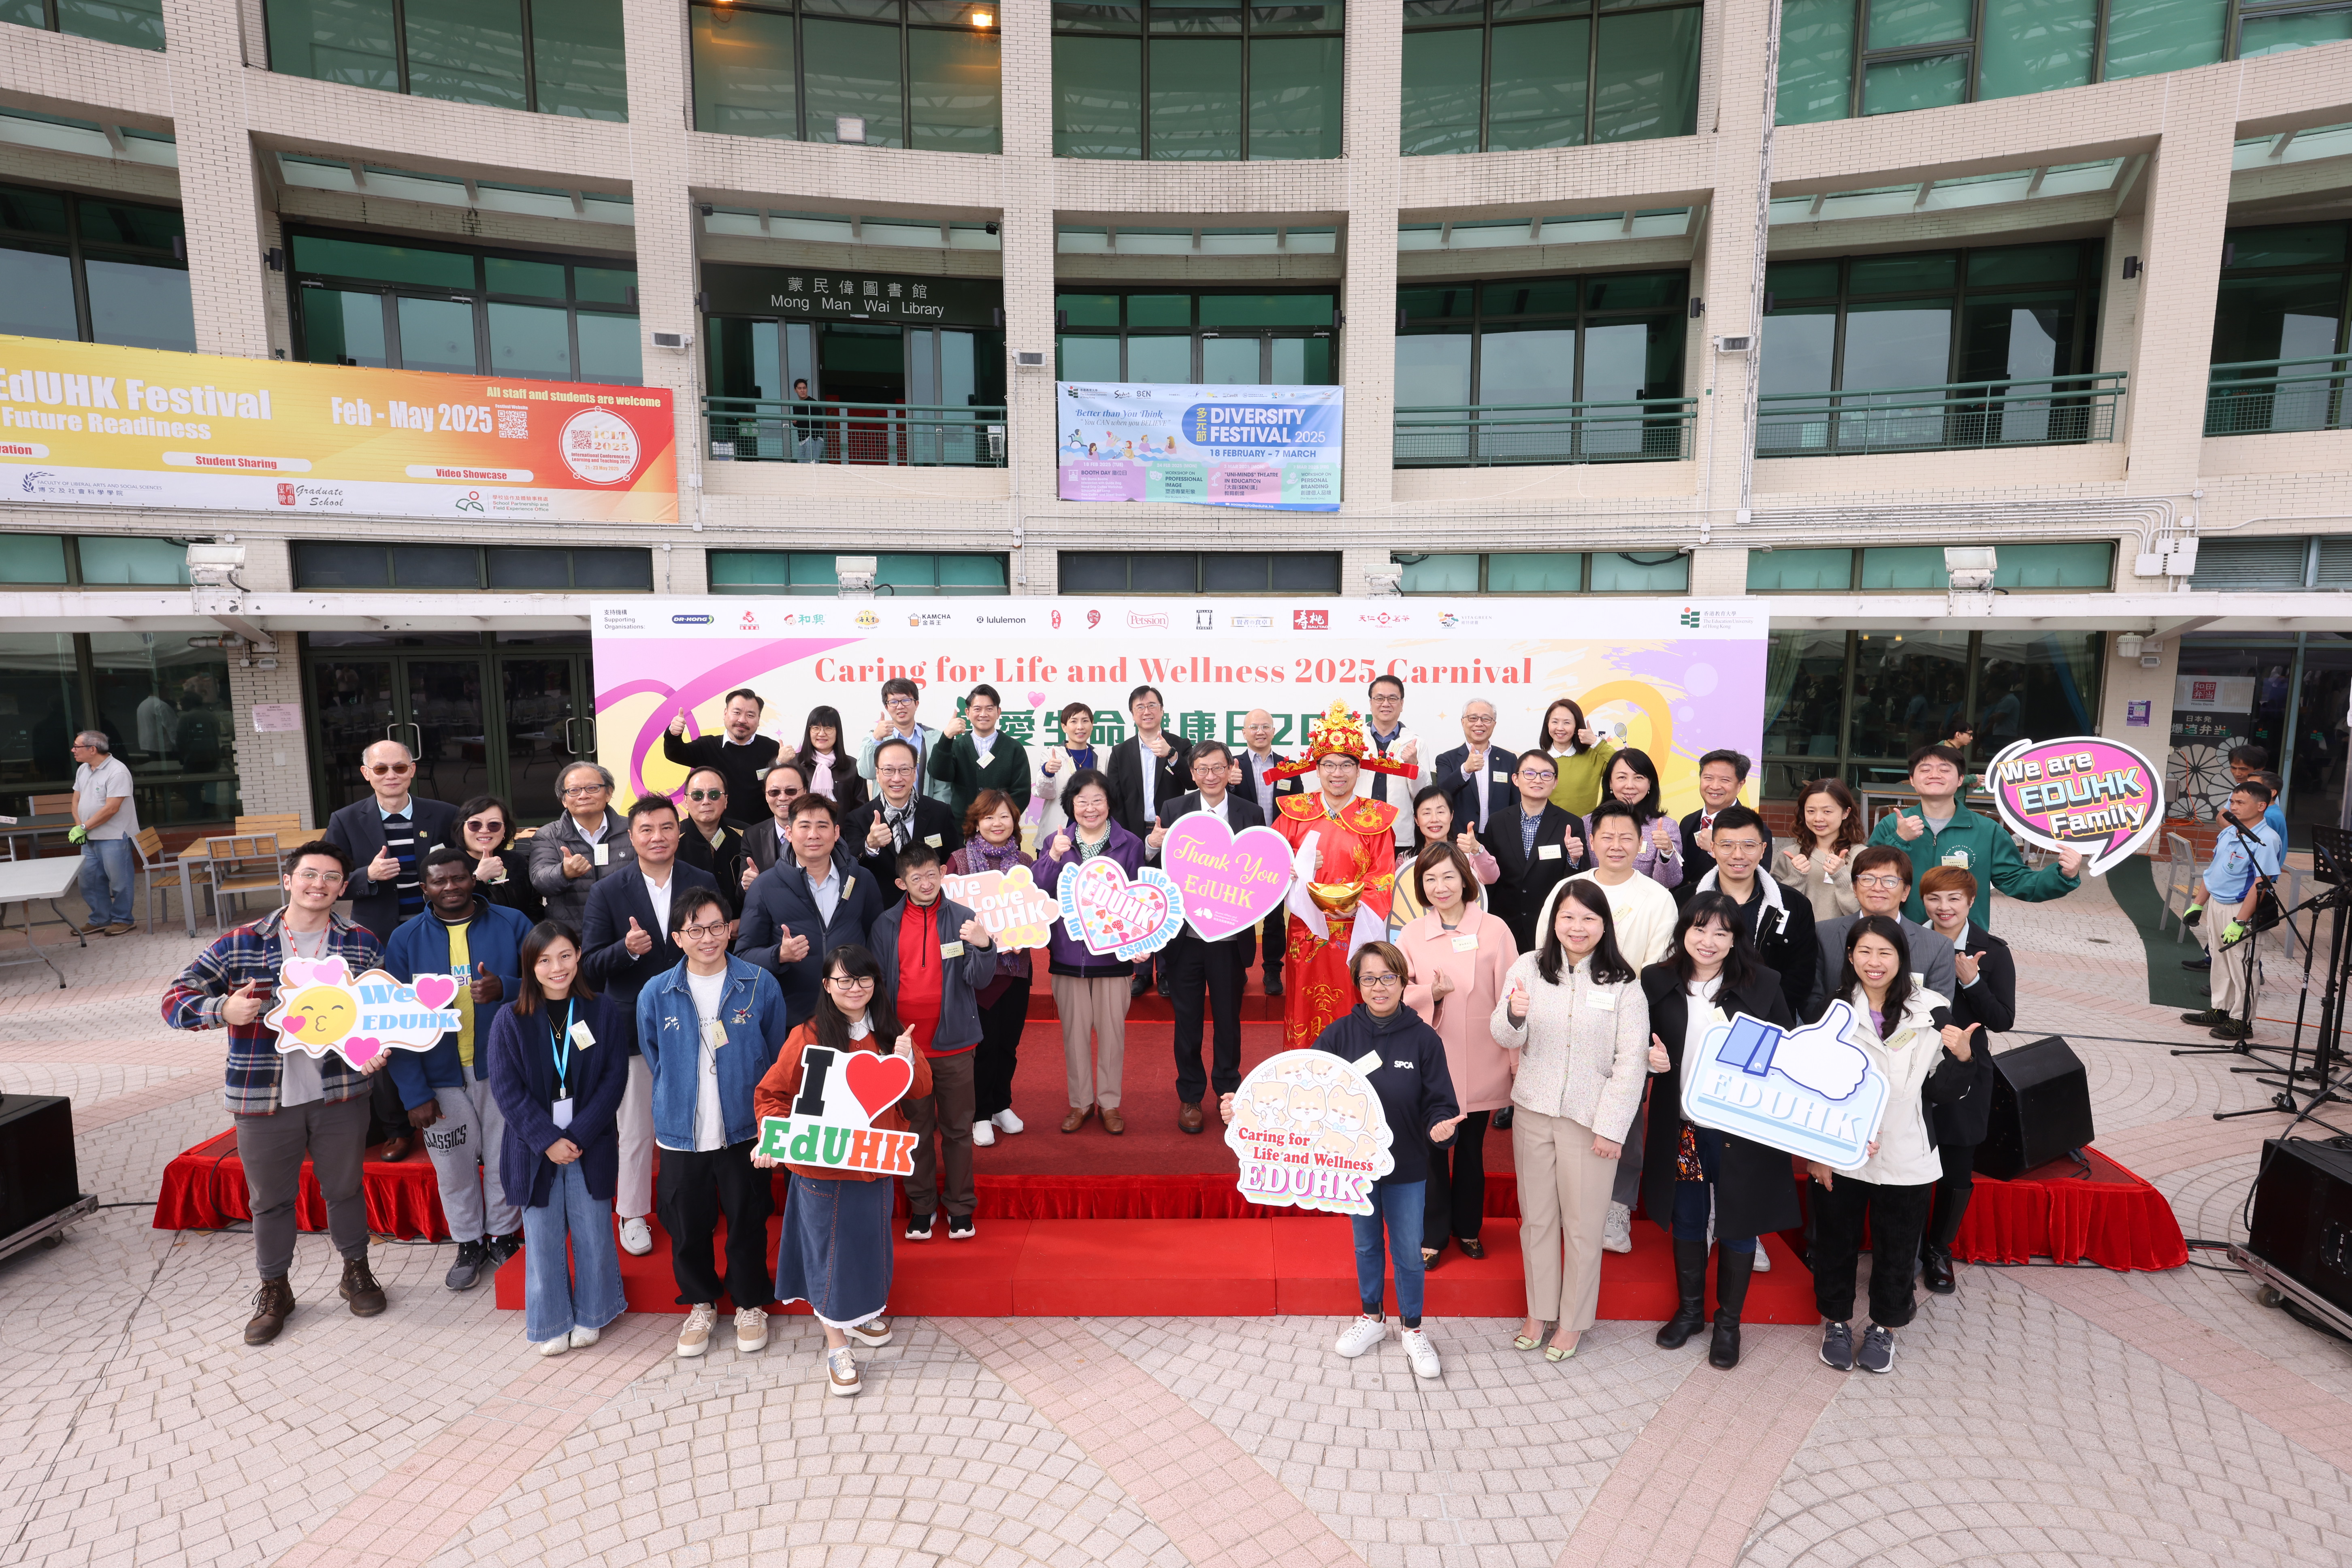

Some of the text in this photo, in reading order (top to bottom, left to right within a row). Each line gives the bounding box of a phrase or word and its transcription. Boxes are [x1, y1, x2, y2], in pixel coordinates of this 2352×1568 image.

[788, 277, 927, 299] 蒙民偉圖書館
[771, 294, 944, 317] Mong Man Wai Library
[126, 378, 272, 420] Festival
[487, 386, 661, 407] All staff and students are welcome
[2, 407, 211, 440] Future Readiness
[331, 396, 492, 433] Feb May 2025
[1075, 409, 1101, 417] Better
[1121, 410, 1137, 419] You
[1140, 410, 1163, 419] Think
[1196, 407, 1207, 442] 多元節
[1210, 408, 1306, 424] DIVERSITY
[1210, 426, 1325, 443] FESTIVAL 2025
[594, 442, 629, 452] 2025
[196, 456, 277, 470] Student Sharing
[436, 469, 507, 479] Video Showcase
[296, 485, 343, 496] Graduate
[310, 497, 343, 506] School
[798, 614, 825, 625] 和興
[1130, 615, 1166, 626] Petssion
[815, 656, 1532, 690] Caring for Life and Wellness 2025 Carnival
[2193, 690, 2214, 699] 弁当
[1999, 752, 2093, 782] We are
[2019, 768, 2144, 812] EDUHK
[2049, 803, 2145, 836] Family
[1173, 835, 1280, 885] Thank You
[941, 880, 981, 899] We
[1061, 866, 1078, 914] Caring
[1141, 871, 1167, 887] Life
[967, 891, 1024, 913] Love
[1165, 886, 1182, 915] and
[1183, 874, 1256, 910] EdUHK
[1081, 877, 1157, 931] EDUHK
[1067, 917, 1083, 937] for
[1118, 917, 1180, 958] Wellness
[358, 984, 415, 1005] We
[362, 1013, 457, 1030] EDUHK
[1394, 1060, 1414, 1069] SPCA
[795, 1048, 835, 1116] I
[1701, 1067, 1863, 1144] EDUHK
[422, 1124, 467, 1149] CLASSICS
[758, 1119, 916, 1173] EdUHK
[1238, 1127, 1310, 1146] Caring for
[1254, 1146, 1374, 1172] Life and Wellness
[1241, 1161, 1363, 1203] EDUHK
